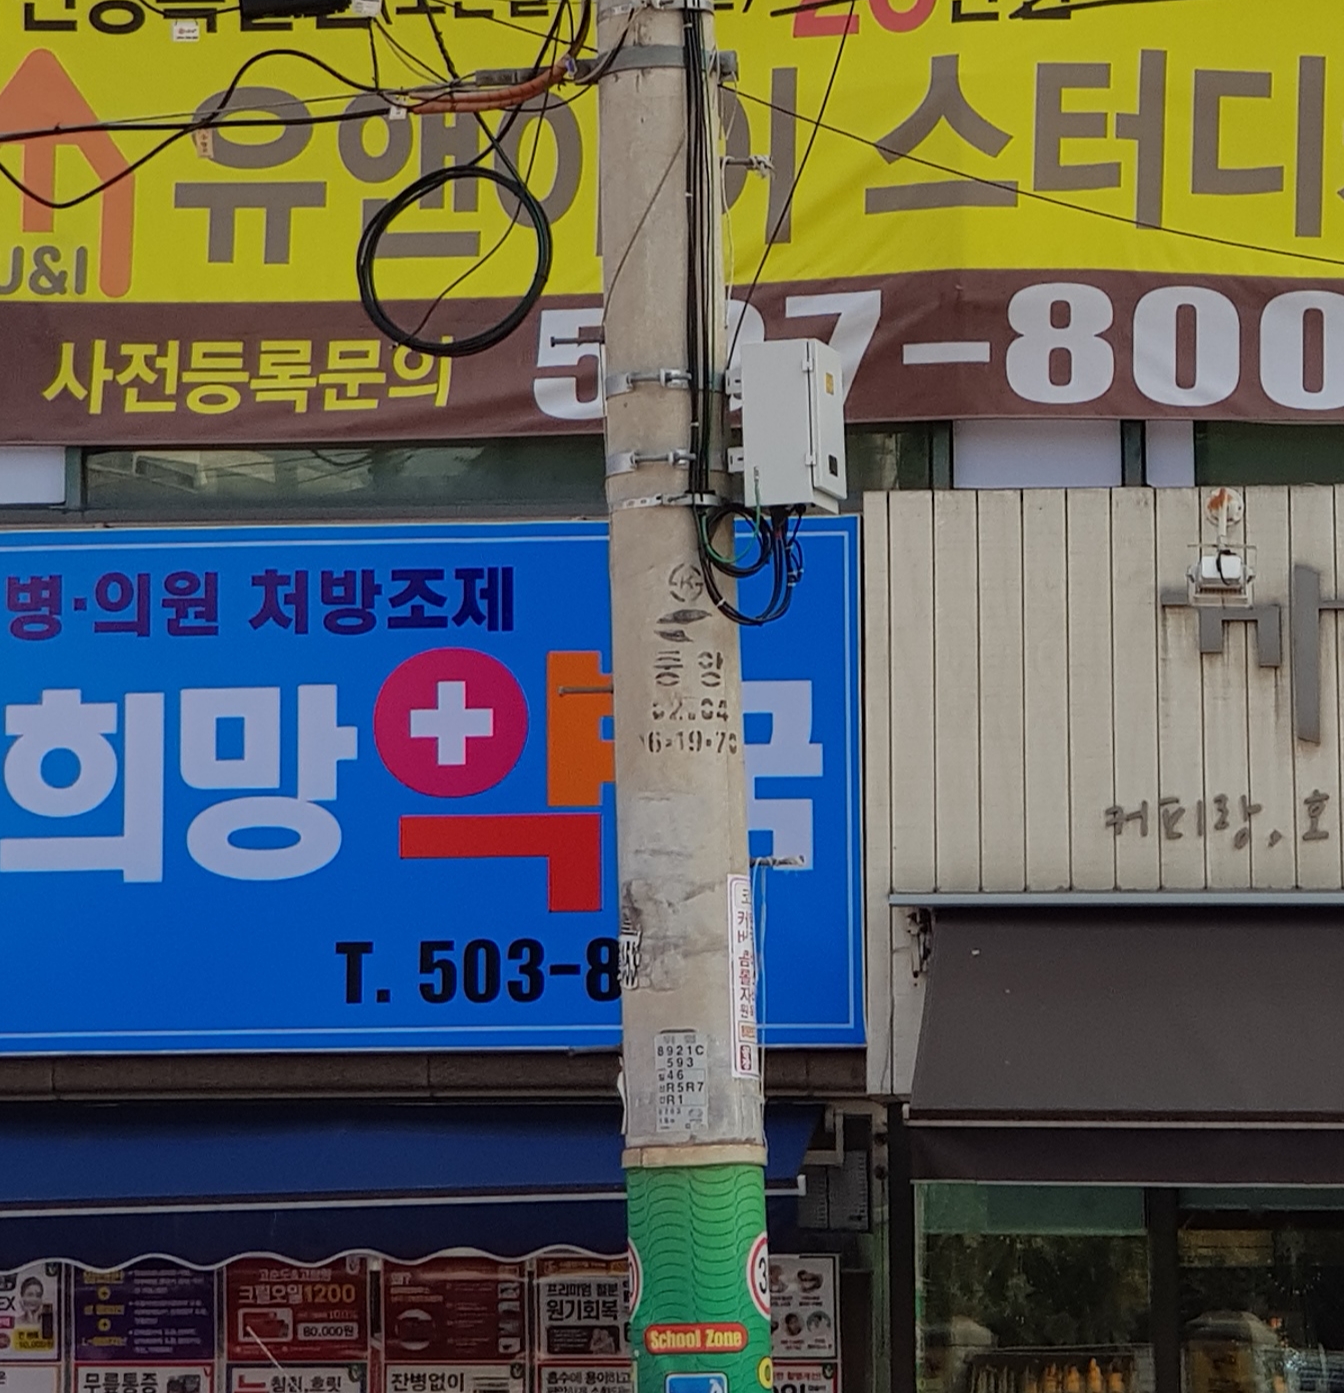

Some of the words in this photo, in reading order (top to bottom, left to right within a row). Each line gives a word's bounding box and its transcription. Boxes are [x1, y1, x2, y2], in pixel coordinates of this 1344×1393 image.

[42, 338, 453, 416] 사전등록문의
[248, 564, 515, 636] 처방조제
[335, 942, 391, 1005] T.
[667, 1057, 693, 1067] 593
[546, 1299, 618, 1321] 원기회복
[650, 1331, 701, 1349] School
[705, 1330, 742, 1347] Zone
